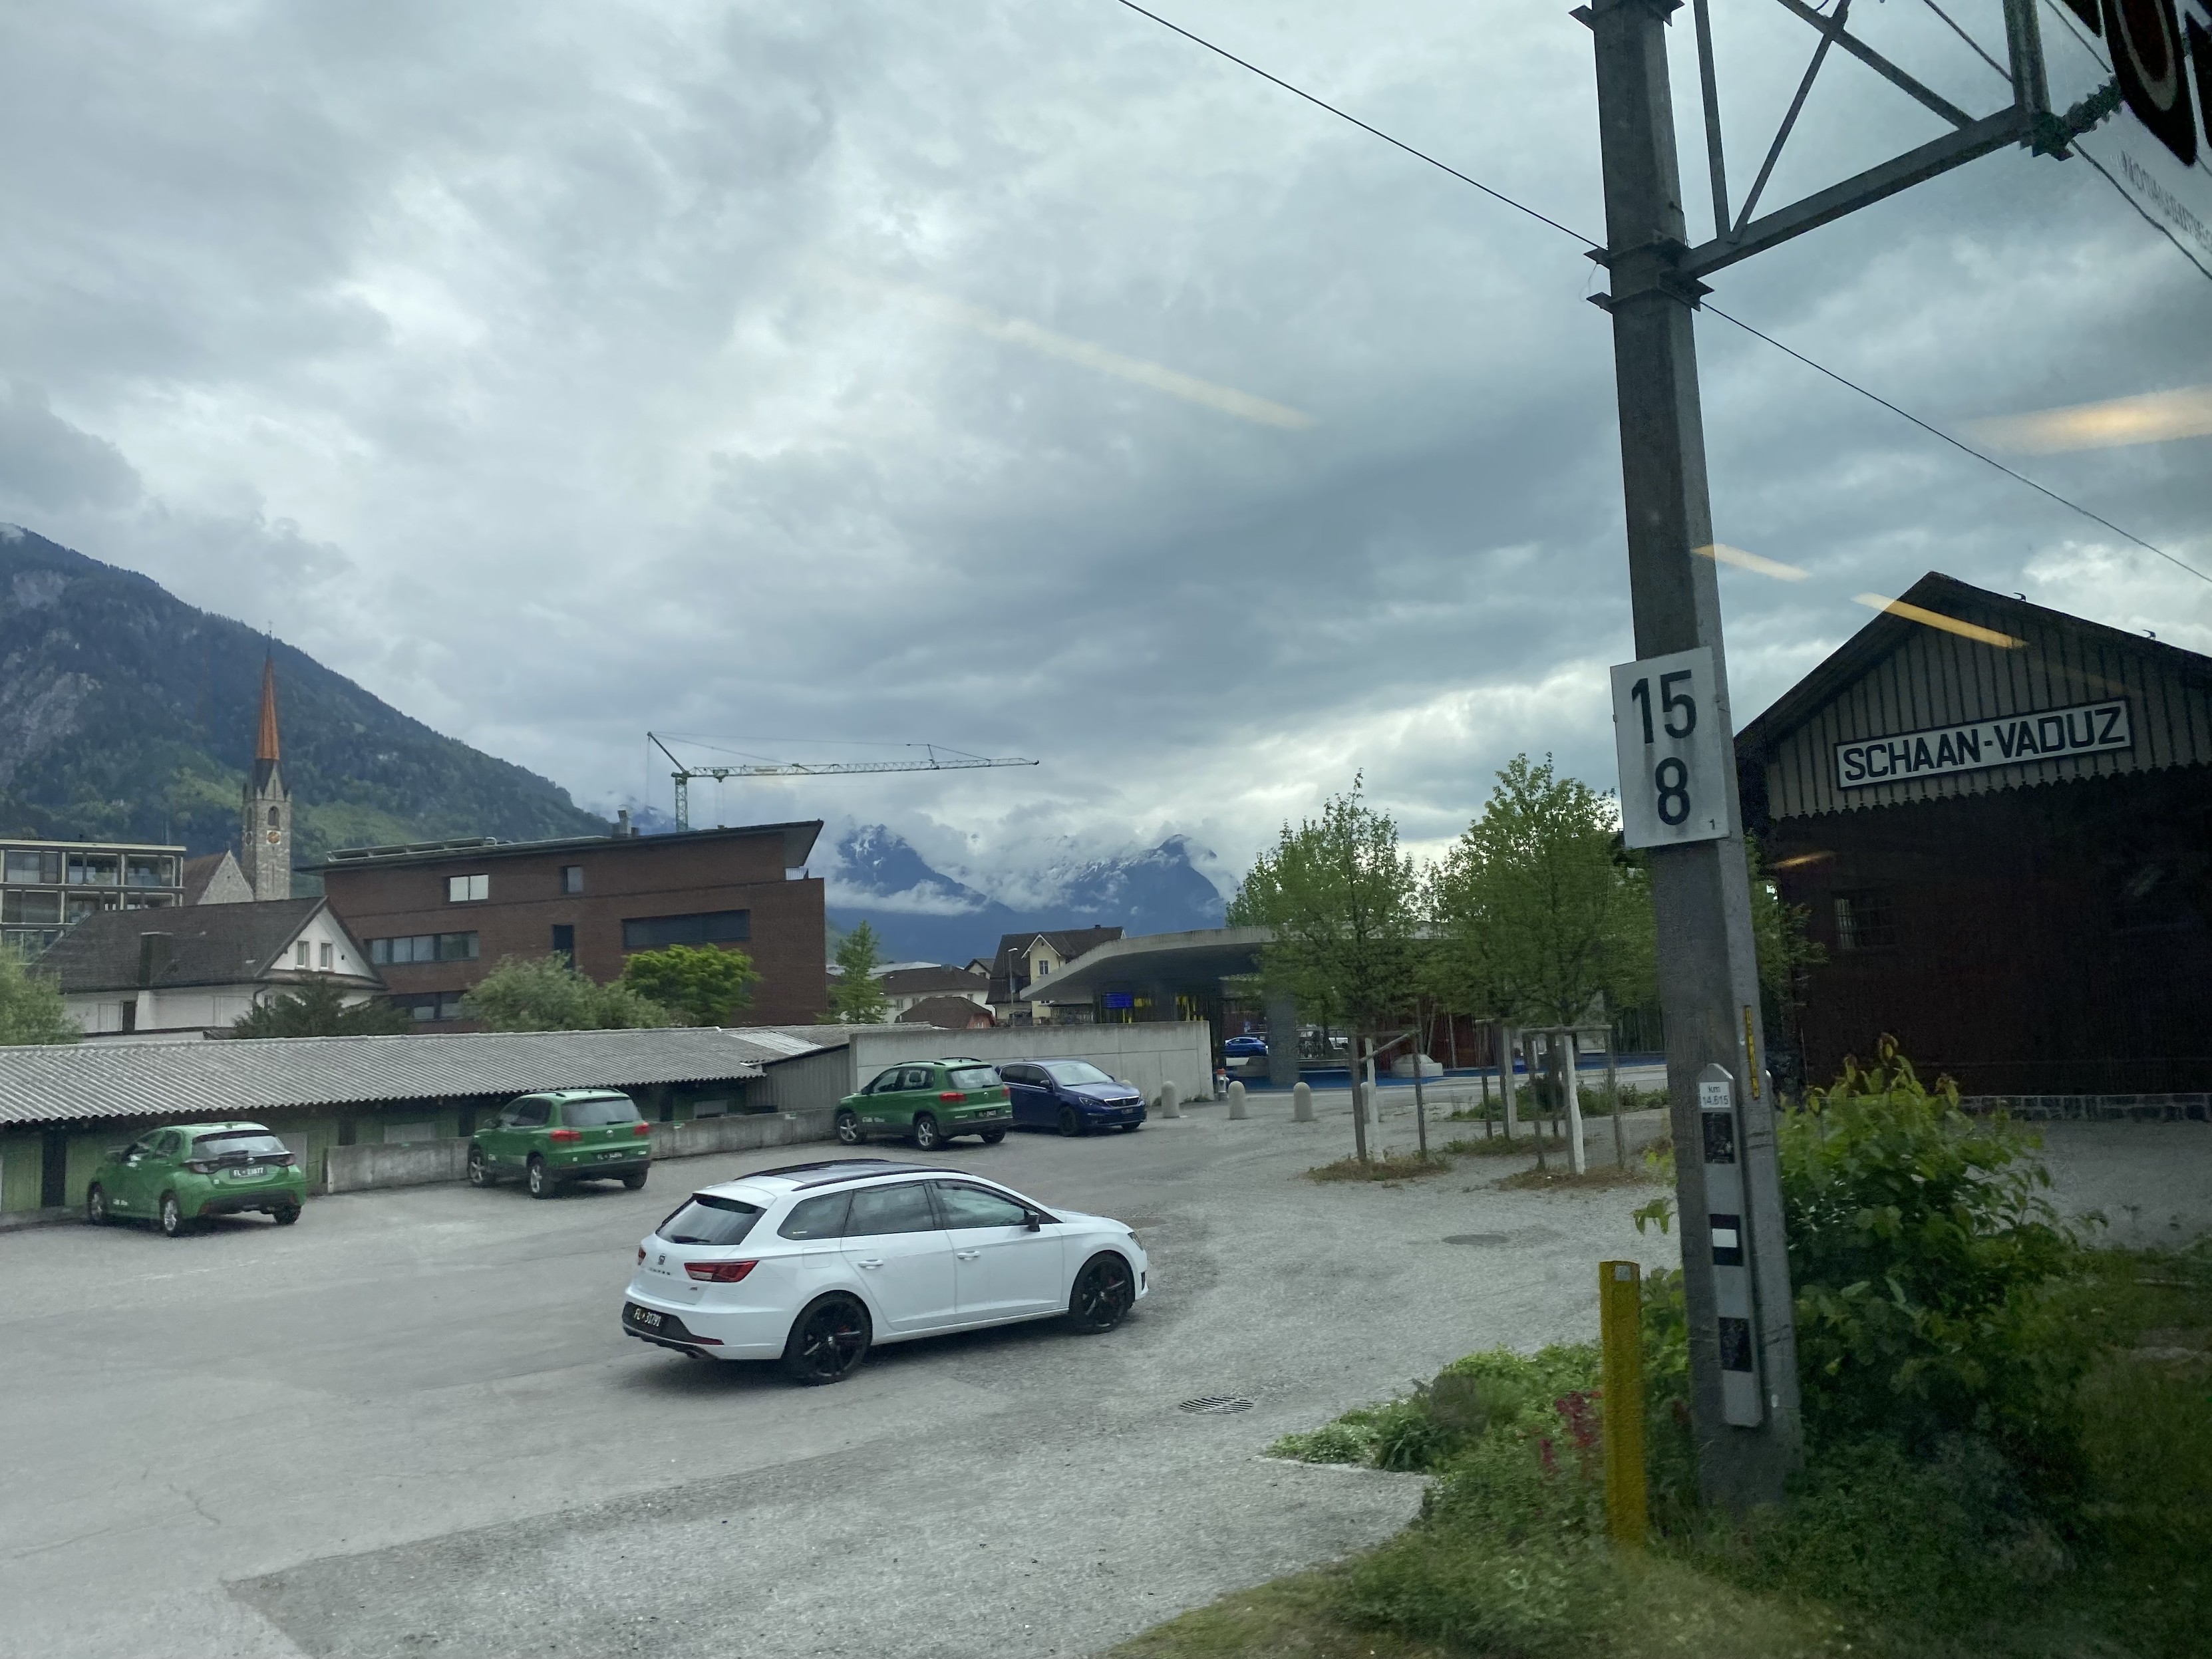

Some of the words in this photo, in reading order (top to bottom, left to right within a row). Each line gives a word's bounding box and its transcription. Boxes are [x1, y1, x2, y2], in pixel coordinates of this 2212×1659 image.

[1631, 669, 1696, 744] 15
[1842, 706, 2126, 782] SCHAAN-VADUZ
[1655, 756, 1690, 826] 8
[633, 1308, 641, 1320] FL
